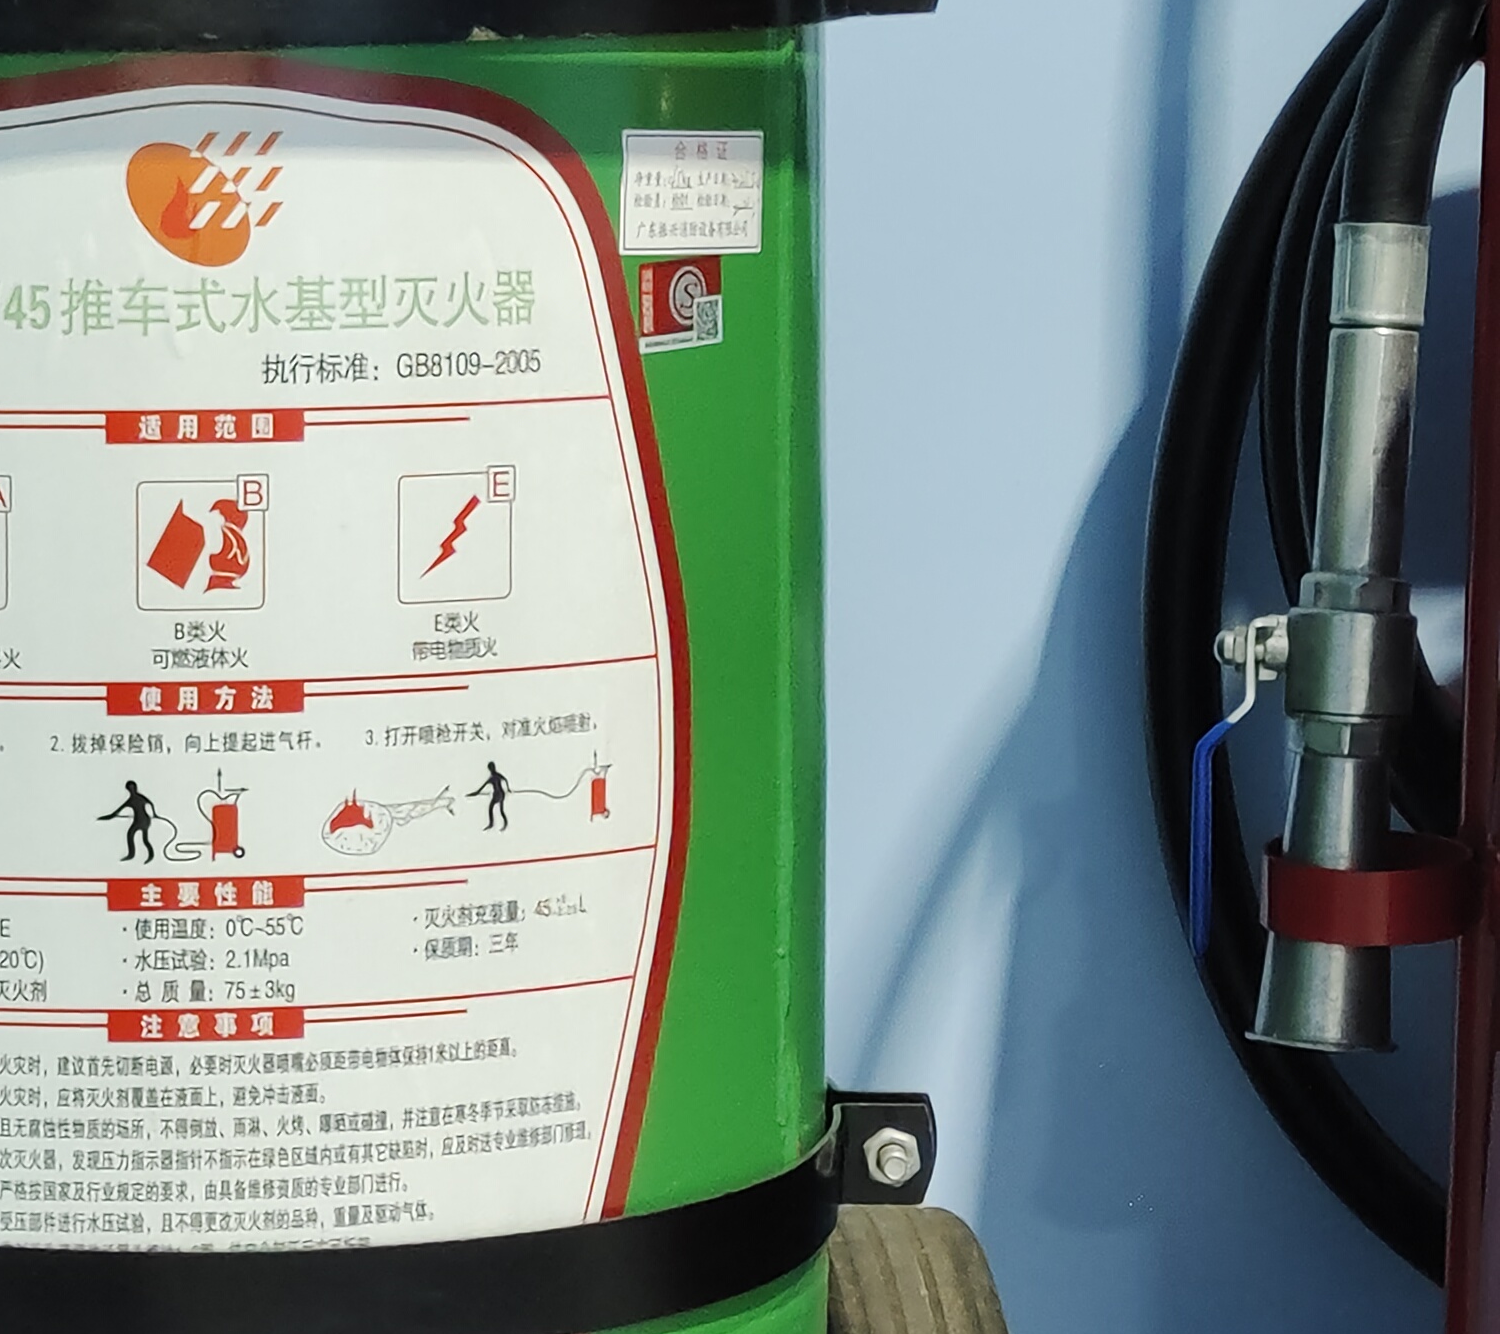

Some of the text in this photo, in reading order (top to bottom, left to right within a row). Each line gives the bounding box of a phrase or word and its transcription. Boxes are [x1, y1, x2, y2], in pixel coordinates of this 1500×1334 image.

[674, 140, 729, 160] 合格证
[138, 413, 274, 440] 适用范围
[242, 480, 262, 507] B
[492, 470, 511, 498] E
[173, 620, 228, 644] B类火
[434, 610, 480, 634] E类火
[150, 646, 250, 670] 可燃液体火
[412, 637, 499, 661] 带电物质火
[138, 685, 274, 712] 使用方法
[139, 880, 274, 908] 主要性能
[139, 1012, 275, 1039] 注意事项
